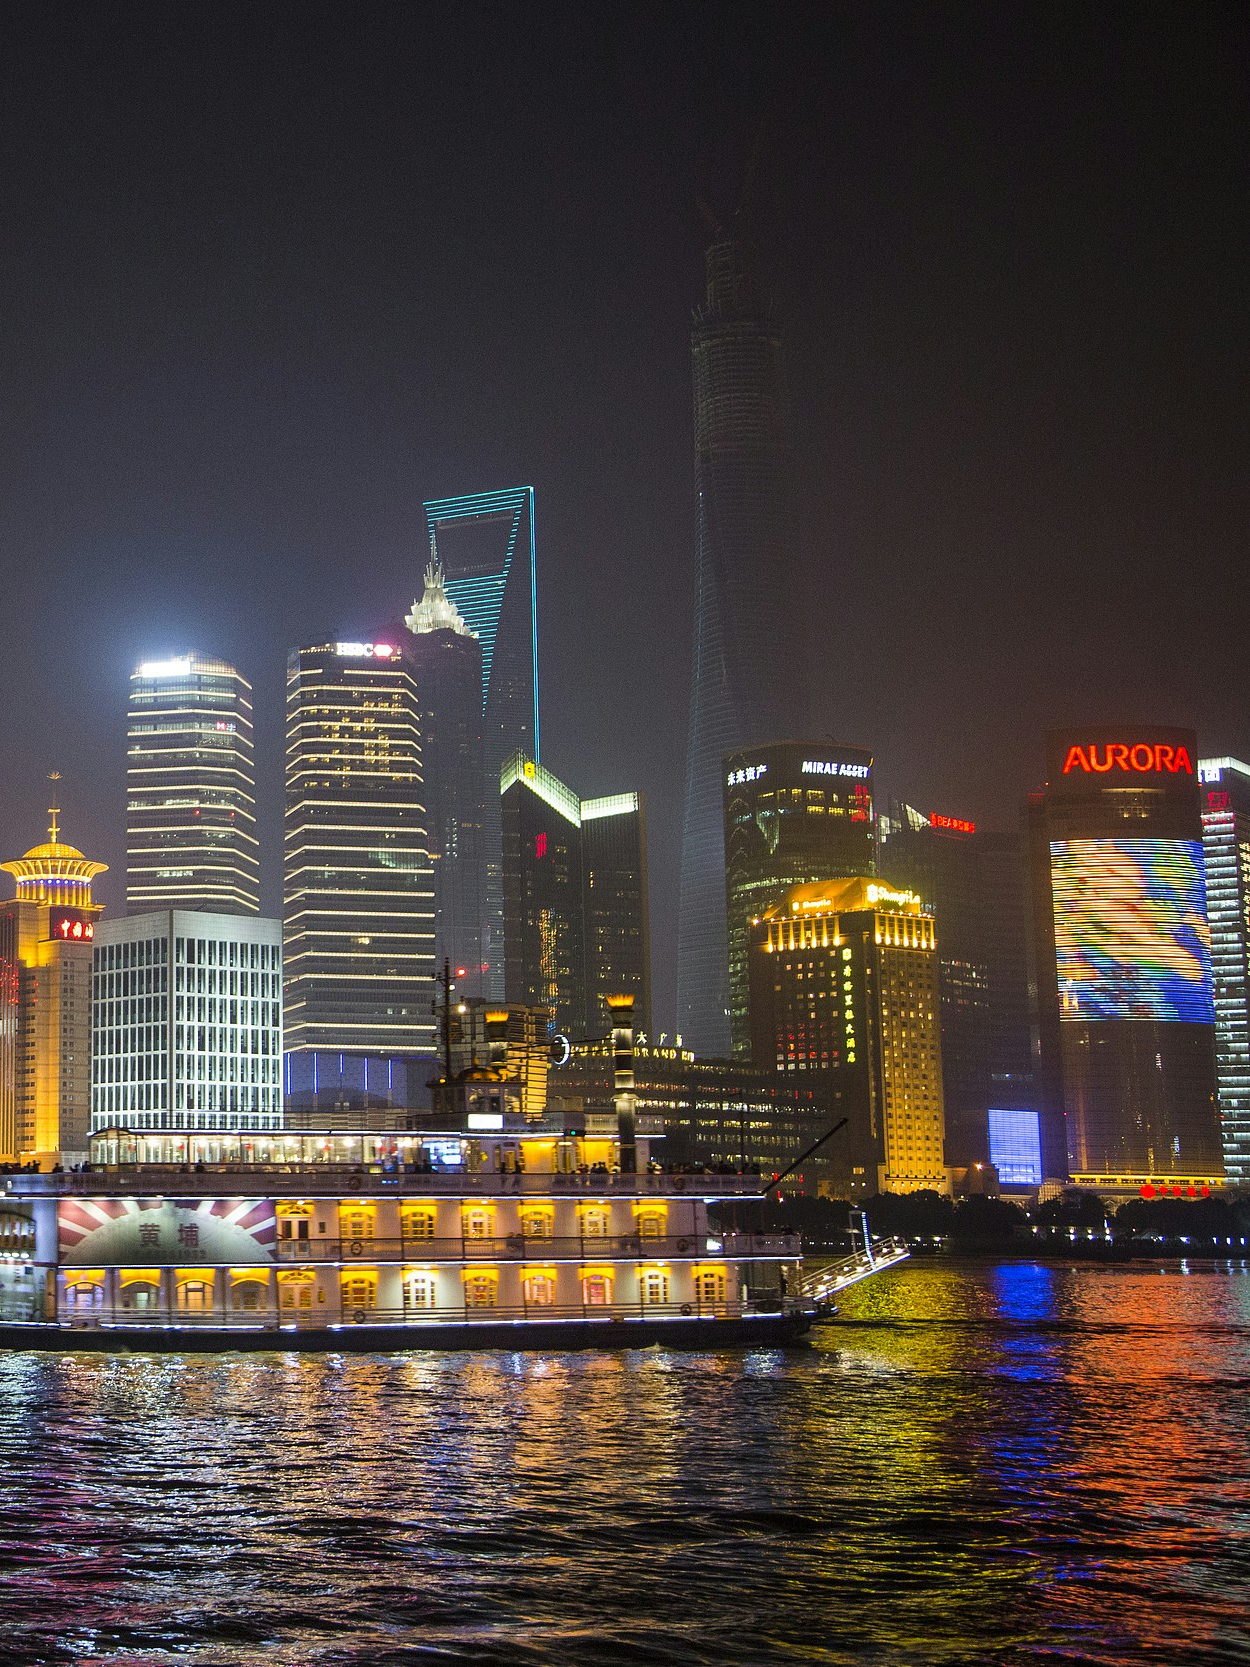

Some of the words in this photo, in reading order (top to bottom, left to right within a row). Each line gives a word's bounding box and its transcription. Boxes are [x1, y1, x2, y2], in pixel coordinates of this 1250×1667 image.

[801, 761, 838, 775] MIRAE
[838, 763, 870, 778] ASSET
[1062, 743, 1193, 775] AURORA
[727, 764, 768, 786] 未来资产
